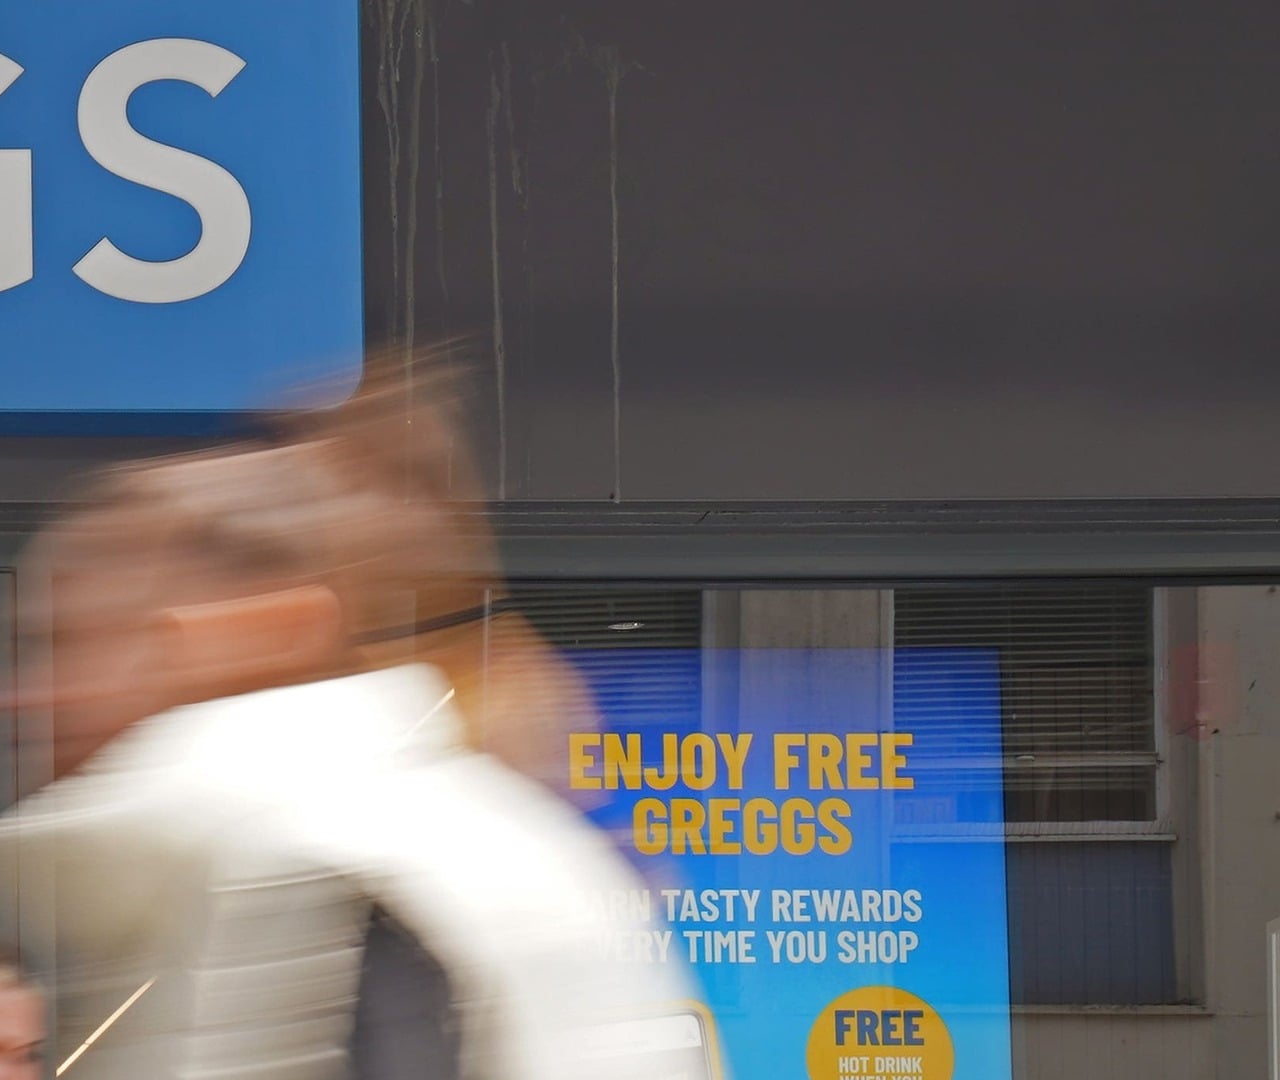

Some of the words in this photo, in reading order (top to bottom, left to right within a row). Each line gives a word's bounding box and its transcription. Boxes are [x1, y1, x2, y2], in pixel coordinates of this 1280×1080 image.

[568, 732, 753, 791] ENJOY
[773, 732, 915, 791] FREE
[632, 797, 853, 856] GREGGS
[660, 889, 762, 922] TASTY
[772, 889, 922, 922] REWARDS
[683, 930, 756, 963] TIME
[765, 930, 829, 964] YOU
[837, 930, 920, 964] SHOP
[834, 1010, 925, 1046] FREE
[839, 1057, 869, 1073] HOT
[874, 1057, 922, 1073] DRINK
